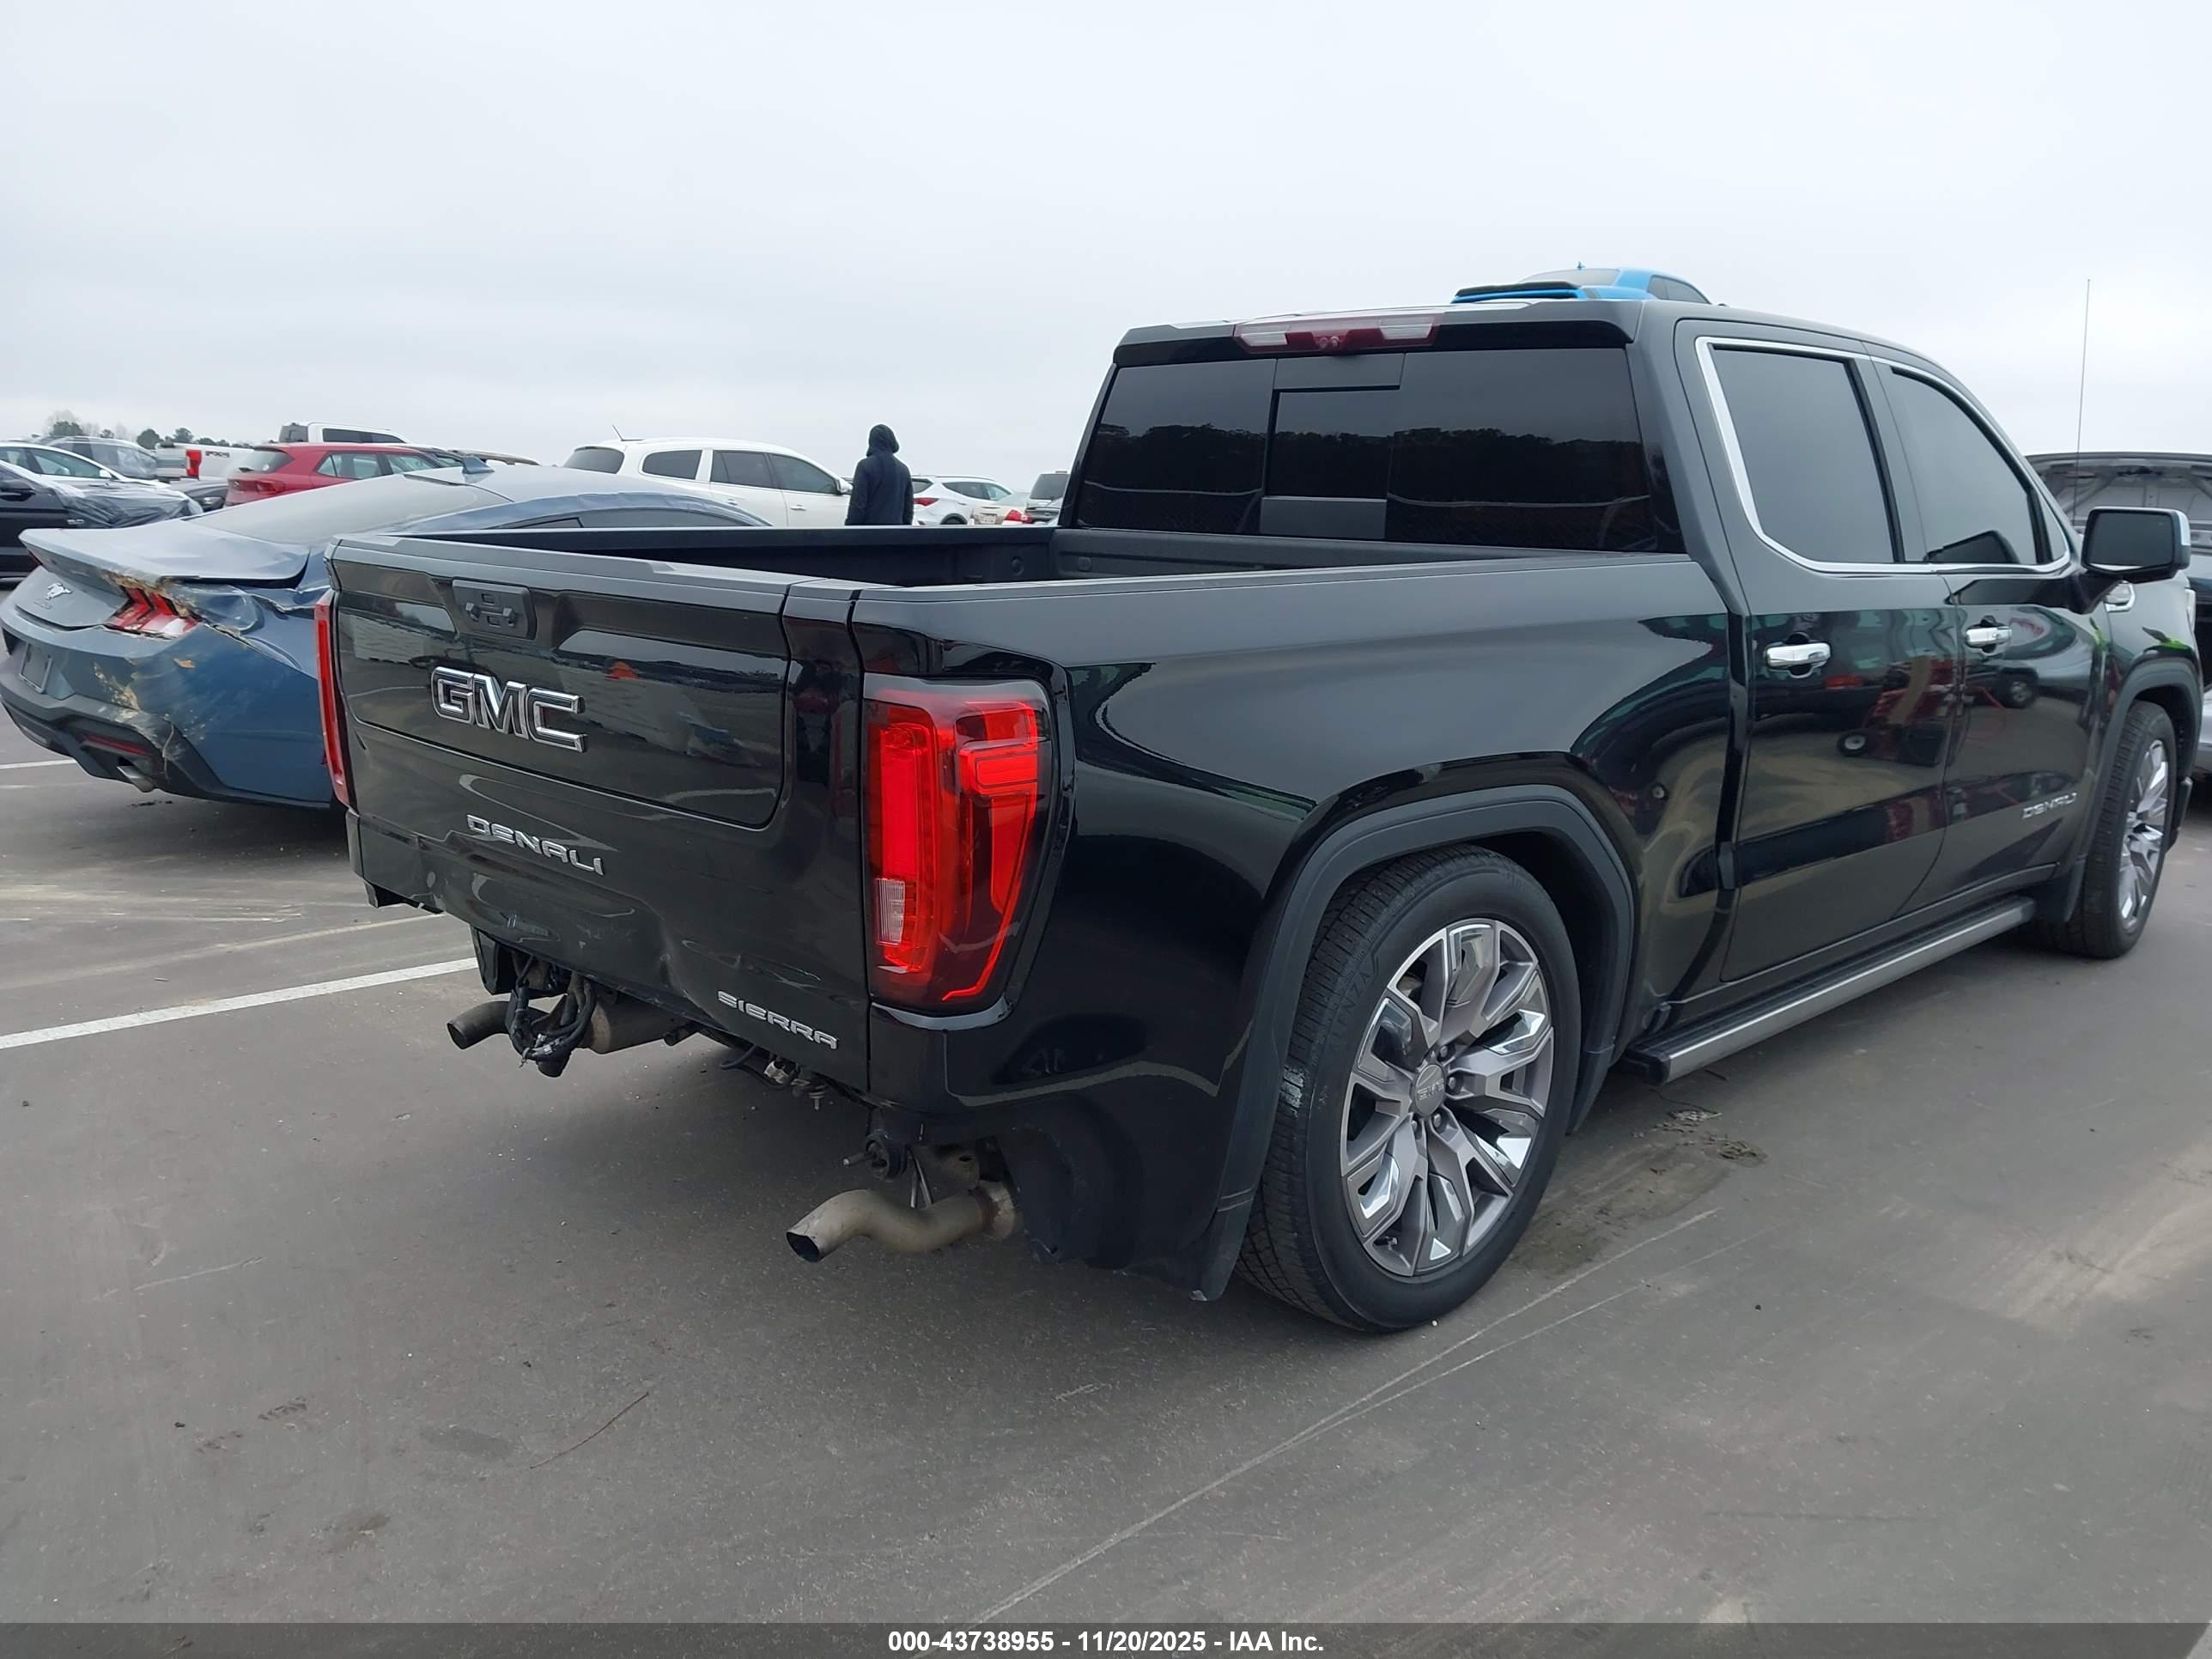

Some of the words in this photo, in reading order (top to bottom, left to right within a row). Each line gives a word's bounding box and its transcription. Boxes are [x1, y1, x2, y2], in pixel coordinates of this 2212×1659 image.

[431, 666, 586, 753] GMC
[466, 814, 605, 876] DENALI
[717, 990, 838, 1049] SIERRA
